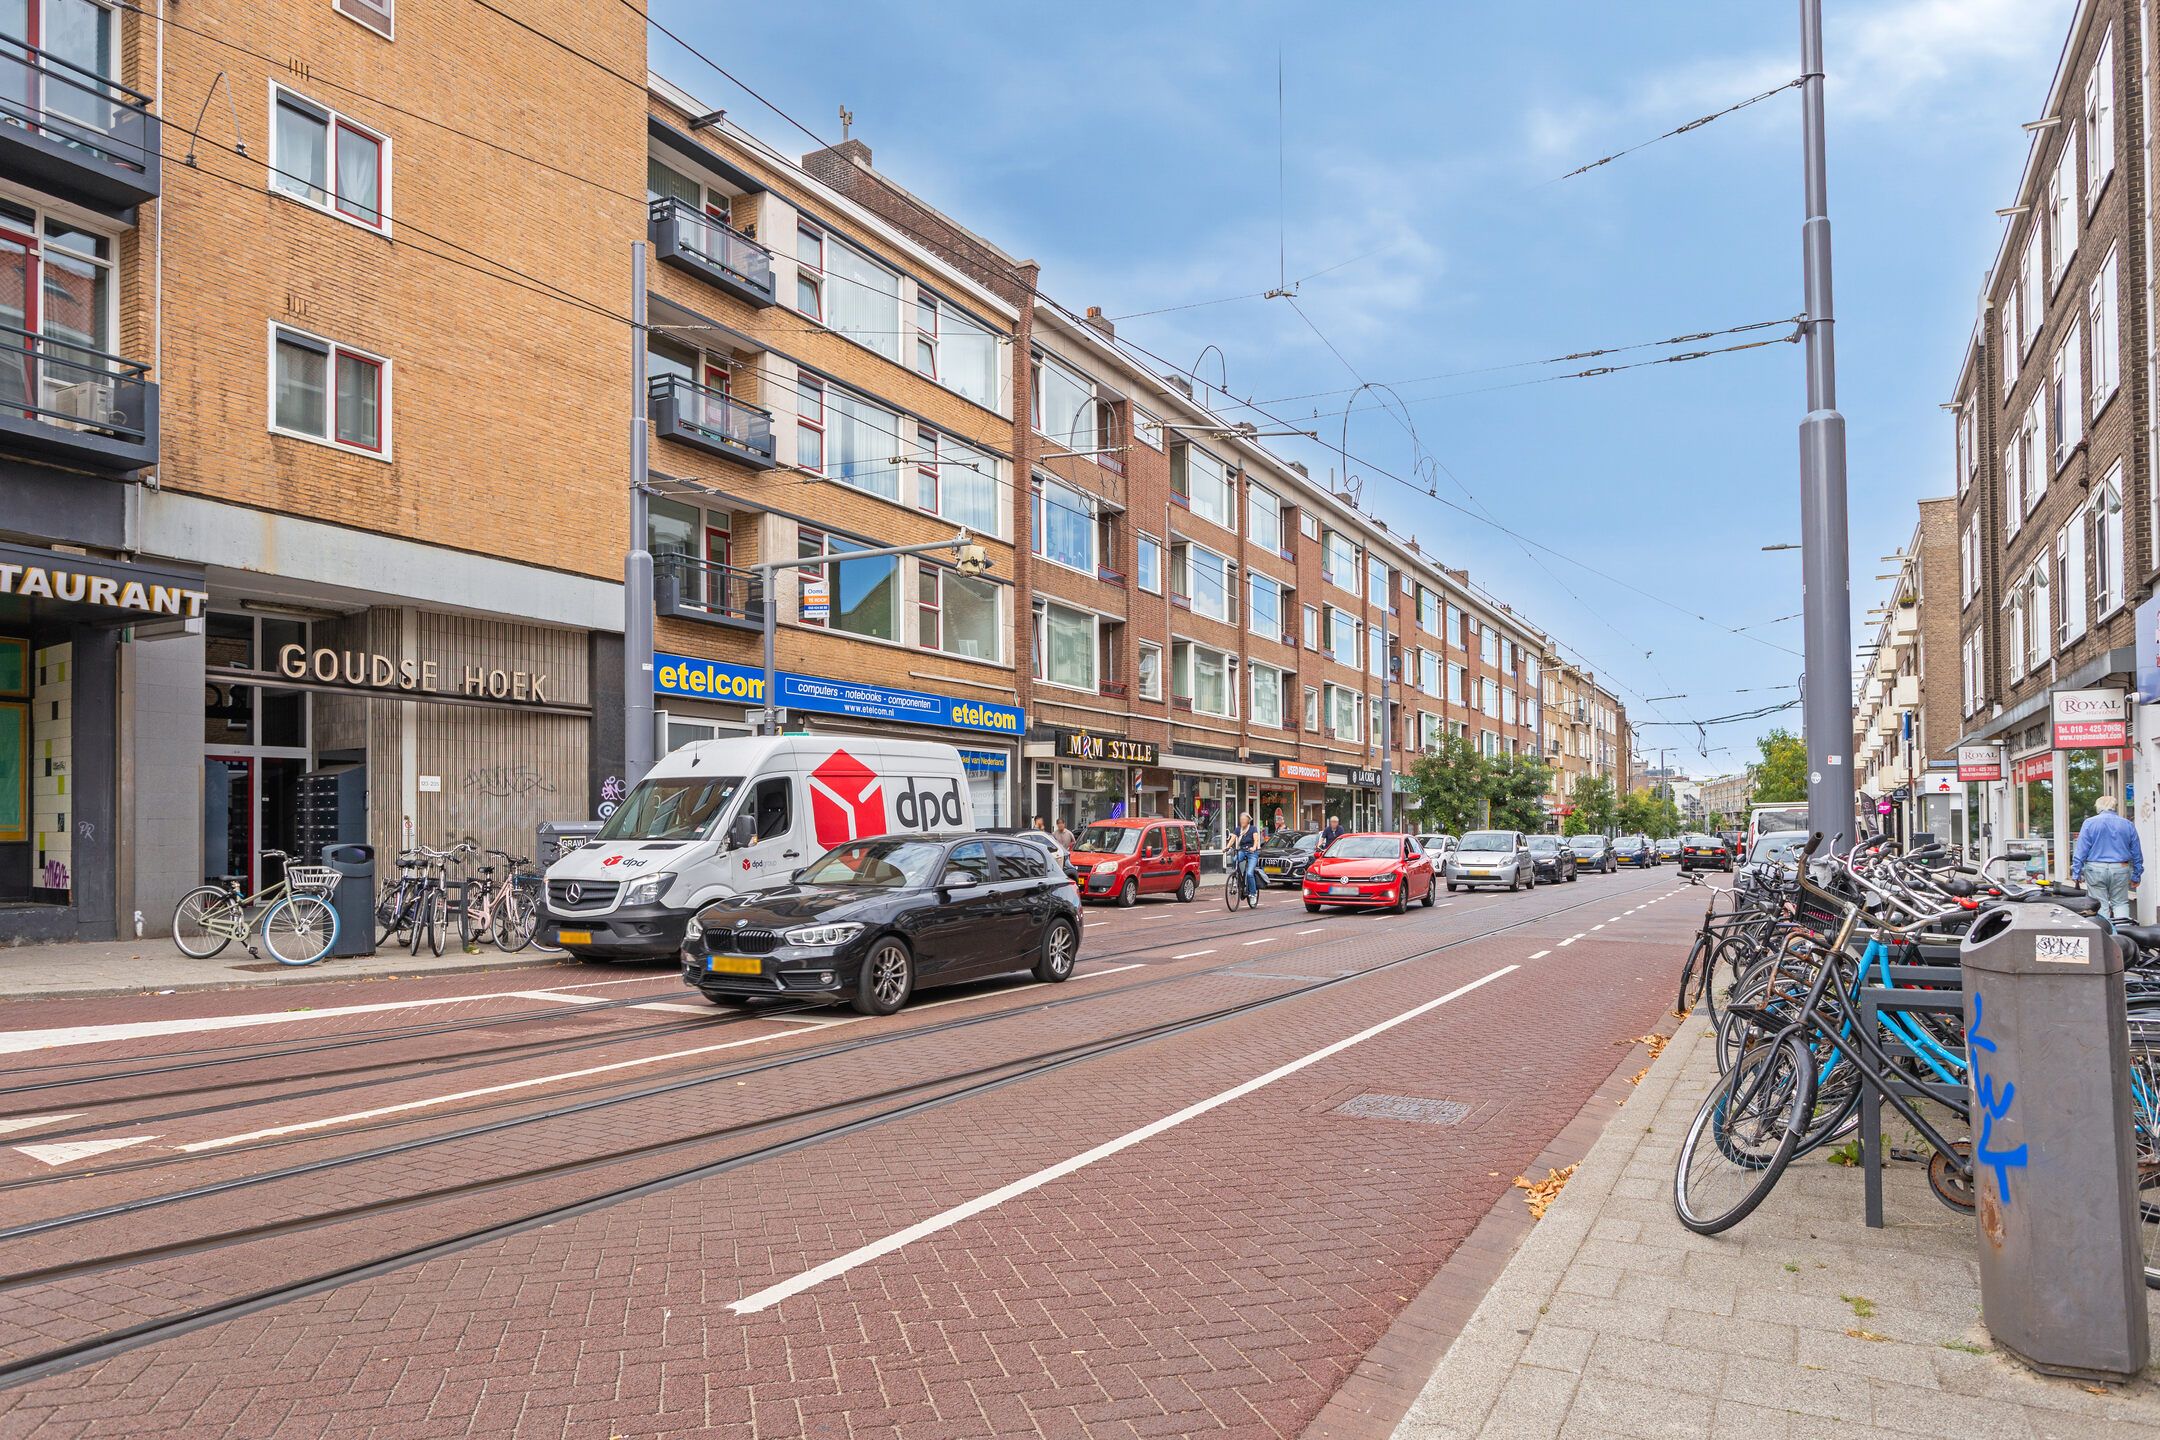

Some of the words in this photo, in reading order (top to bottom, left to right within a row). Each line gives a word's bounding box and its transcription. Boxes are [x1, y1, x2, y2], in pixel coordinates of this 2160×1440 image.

[279, 643, 437, 692] GOUDSE
[463, 665, 547, 703] HOEK
[797, 682, 838, 697] computers
[845, 690, 882, 703] notebooks
[888, 696, 931, 709] componenten
[844, 703, 894, 717] www.etelcom.nl
[2065, 700, 2121, 712] ROYAL
[952, 703, 1017, 729] etelcom
[2058, 726, 2069, 734] Tel.
[2070, 725, 2083, 733] 010
[1112, 741, 1152, 762] STYLE
[1964, 751, 1998, 760] ROYAL
[1287, 765, 1298, 775] USED
[1299, 766, 1321, 778] PRODUCTS
[896, 776, 963, 832] dpd
[622, 857, 648, 868] dpd
